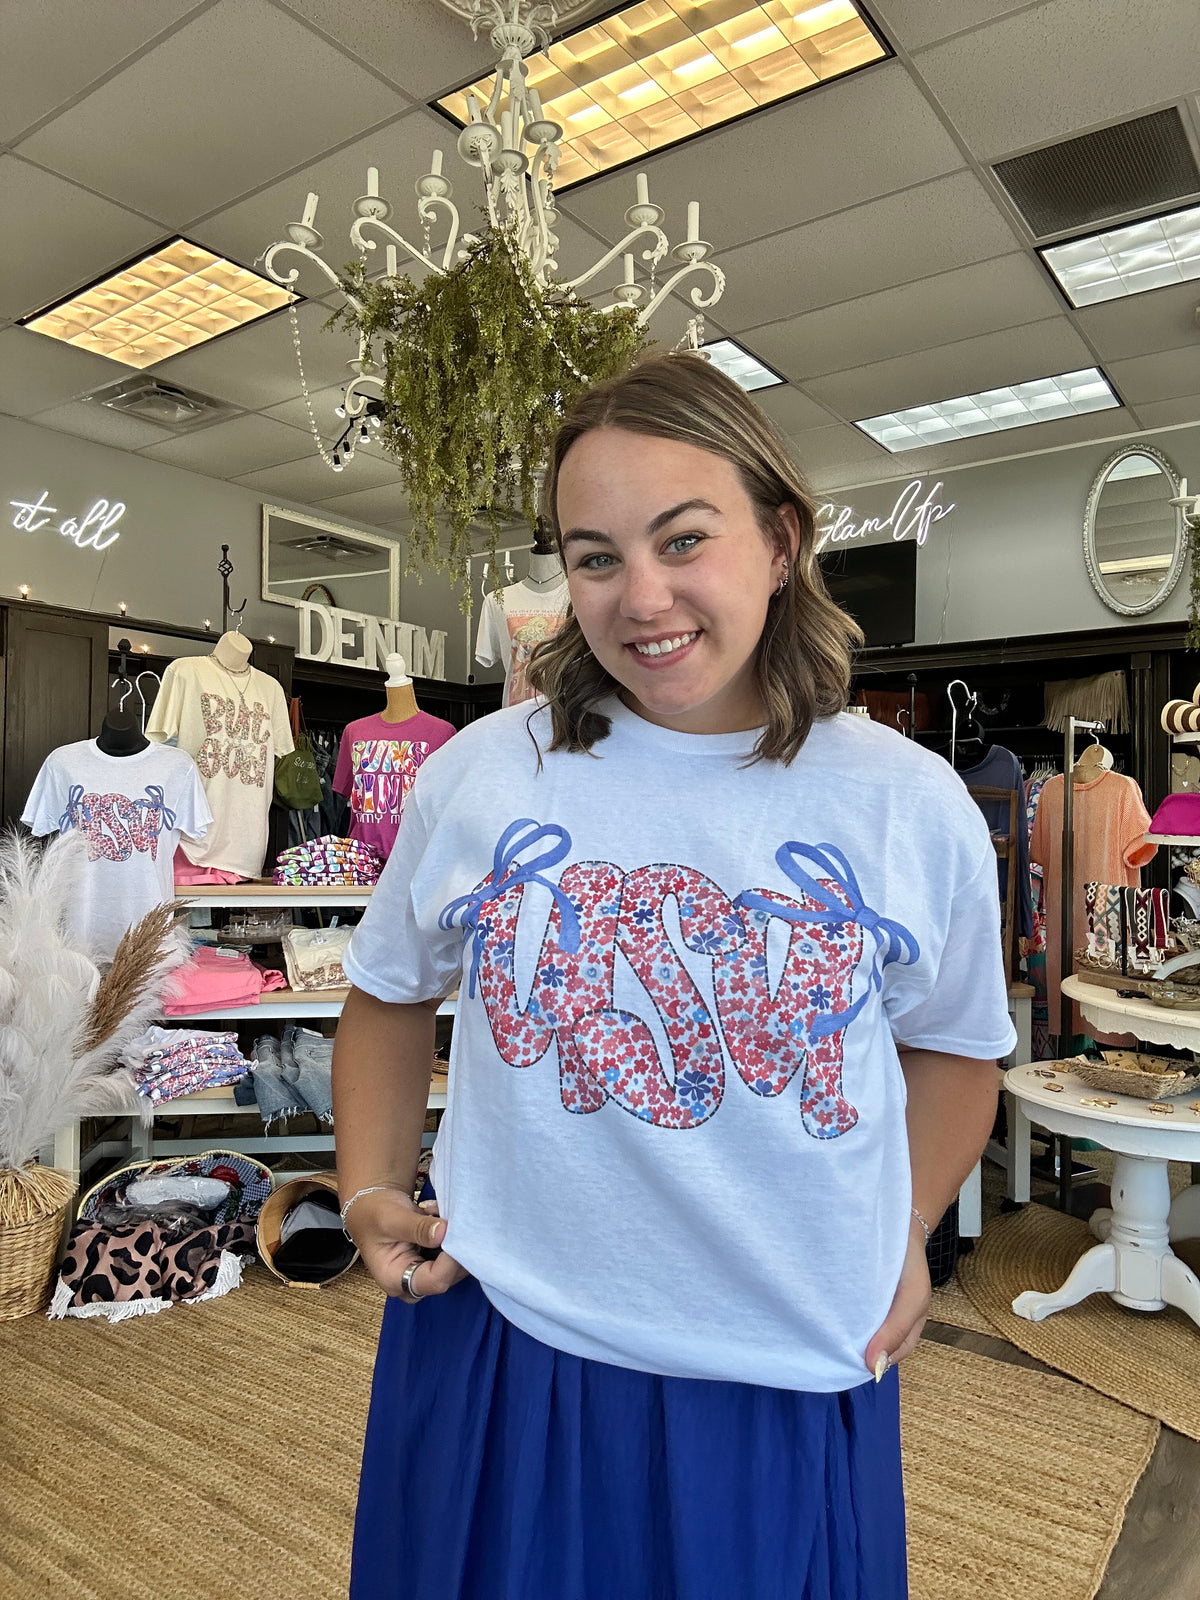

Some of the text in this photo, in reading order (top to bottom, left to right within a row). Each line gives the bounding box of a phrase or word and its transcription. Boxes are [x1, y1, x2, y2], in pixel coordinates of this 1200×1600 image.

[9, 490, 126, 550] it all
[814, 480, 956, 554] Glam Up
[295, 600, 448, 681] DENIM
